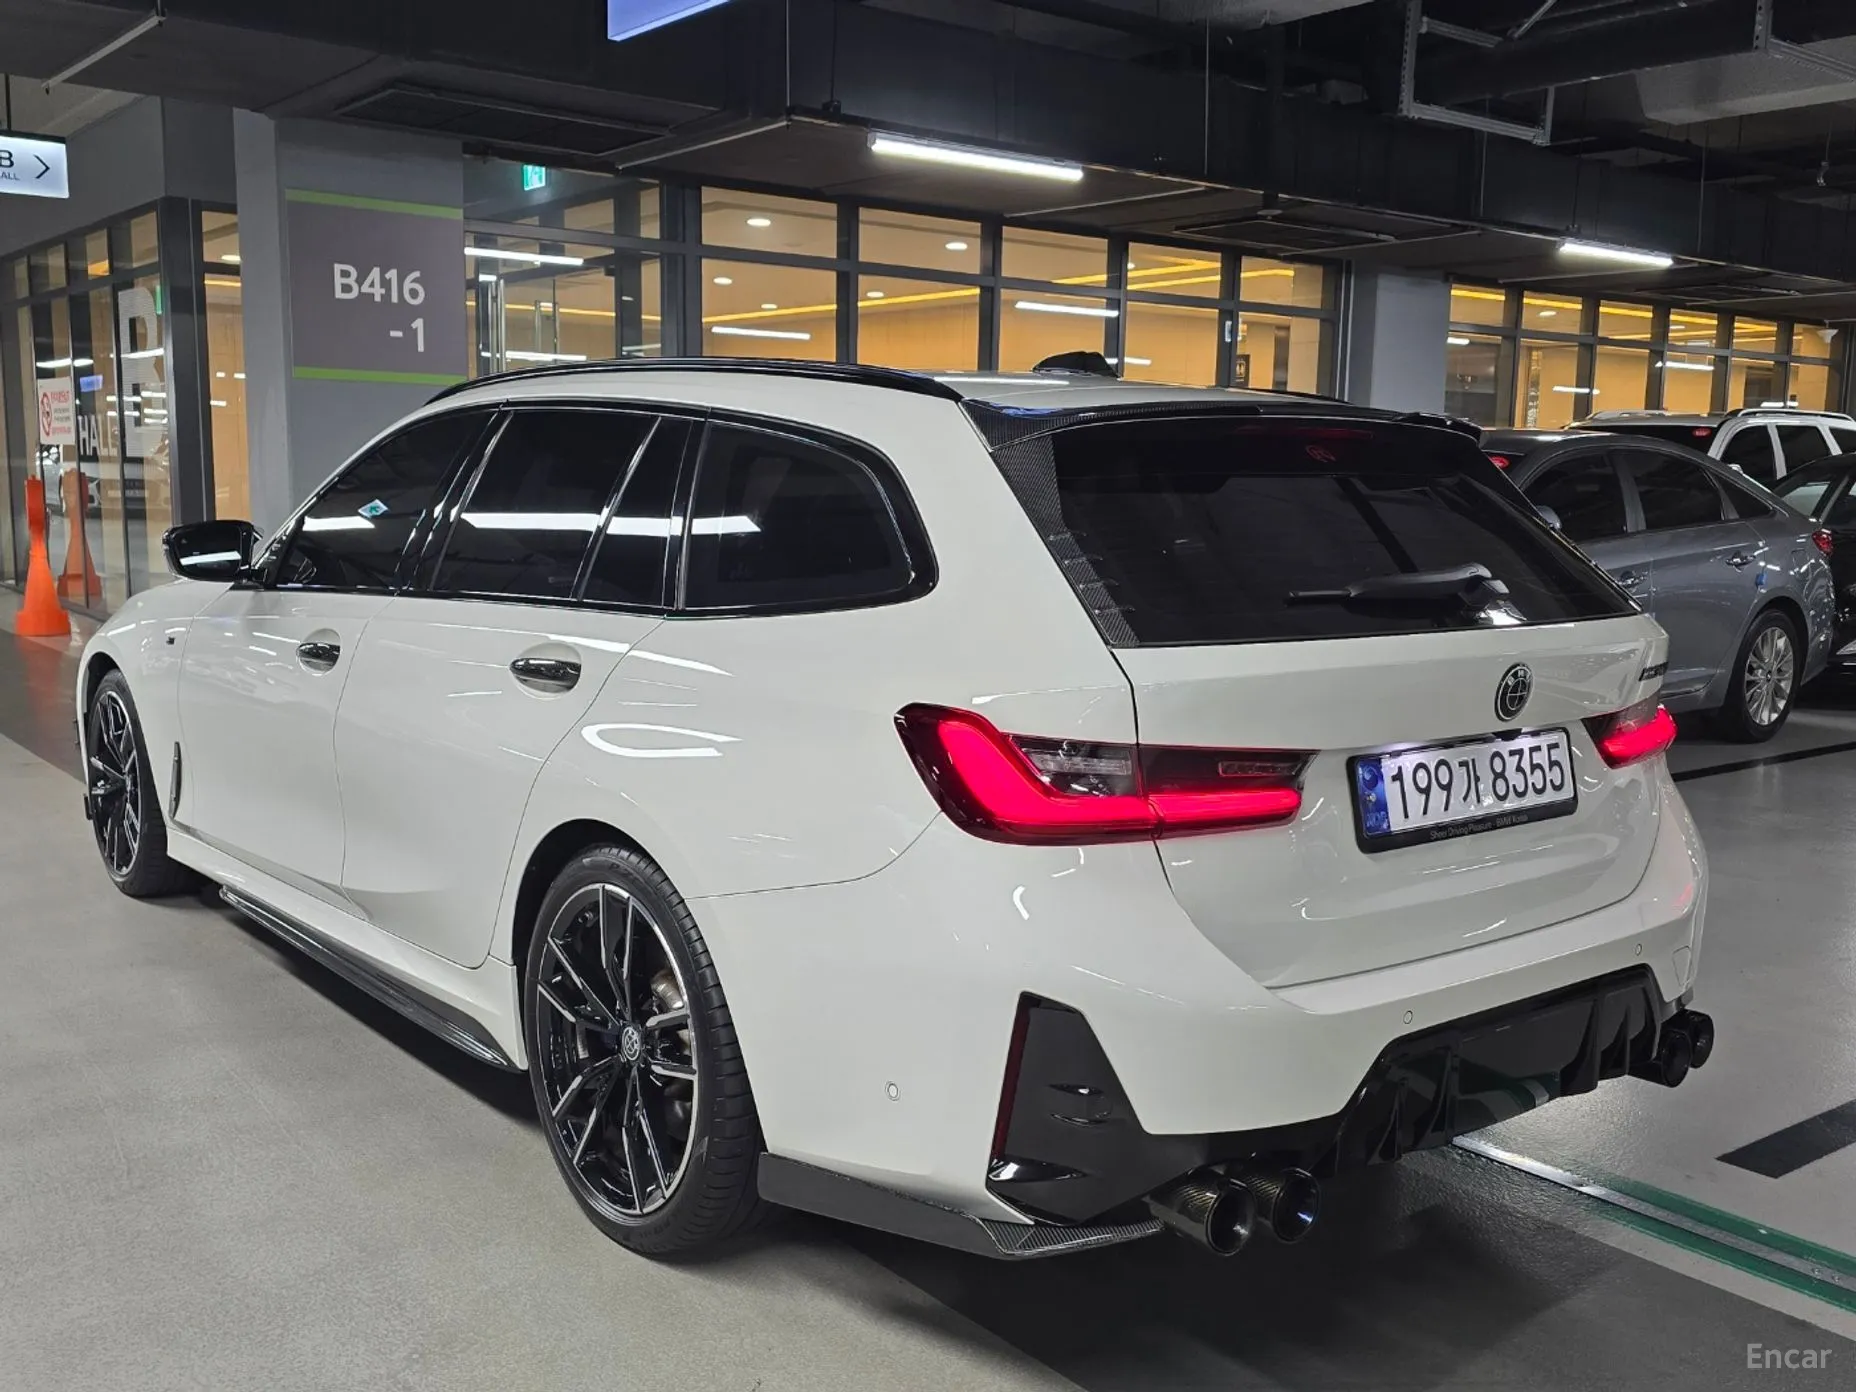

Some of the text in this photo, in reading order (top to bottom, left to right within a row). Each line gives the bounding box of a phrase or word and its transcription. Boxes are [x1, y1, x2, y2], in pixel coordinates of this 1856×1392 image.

[0, 171, 21, 181] ALL
[333, 263, 425, 305] B416
[77, 415, 118, 456] HALL
[1391, 742, 1566, 819] 199가 8355
